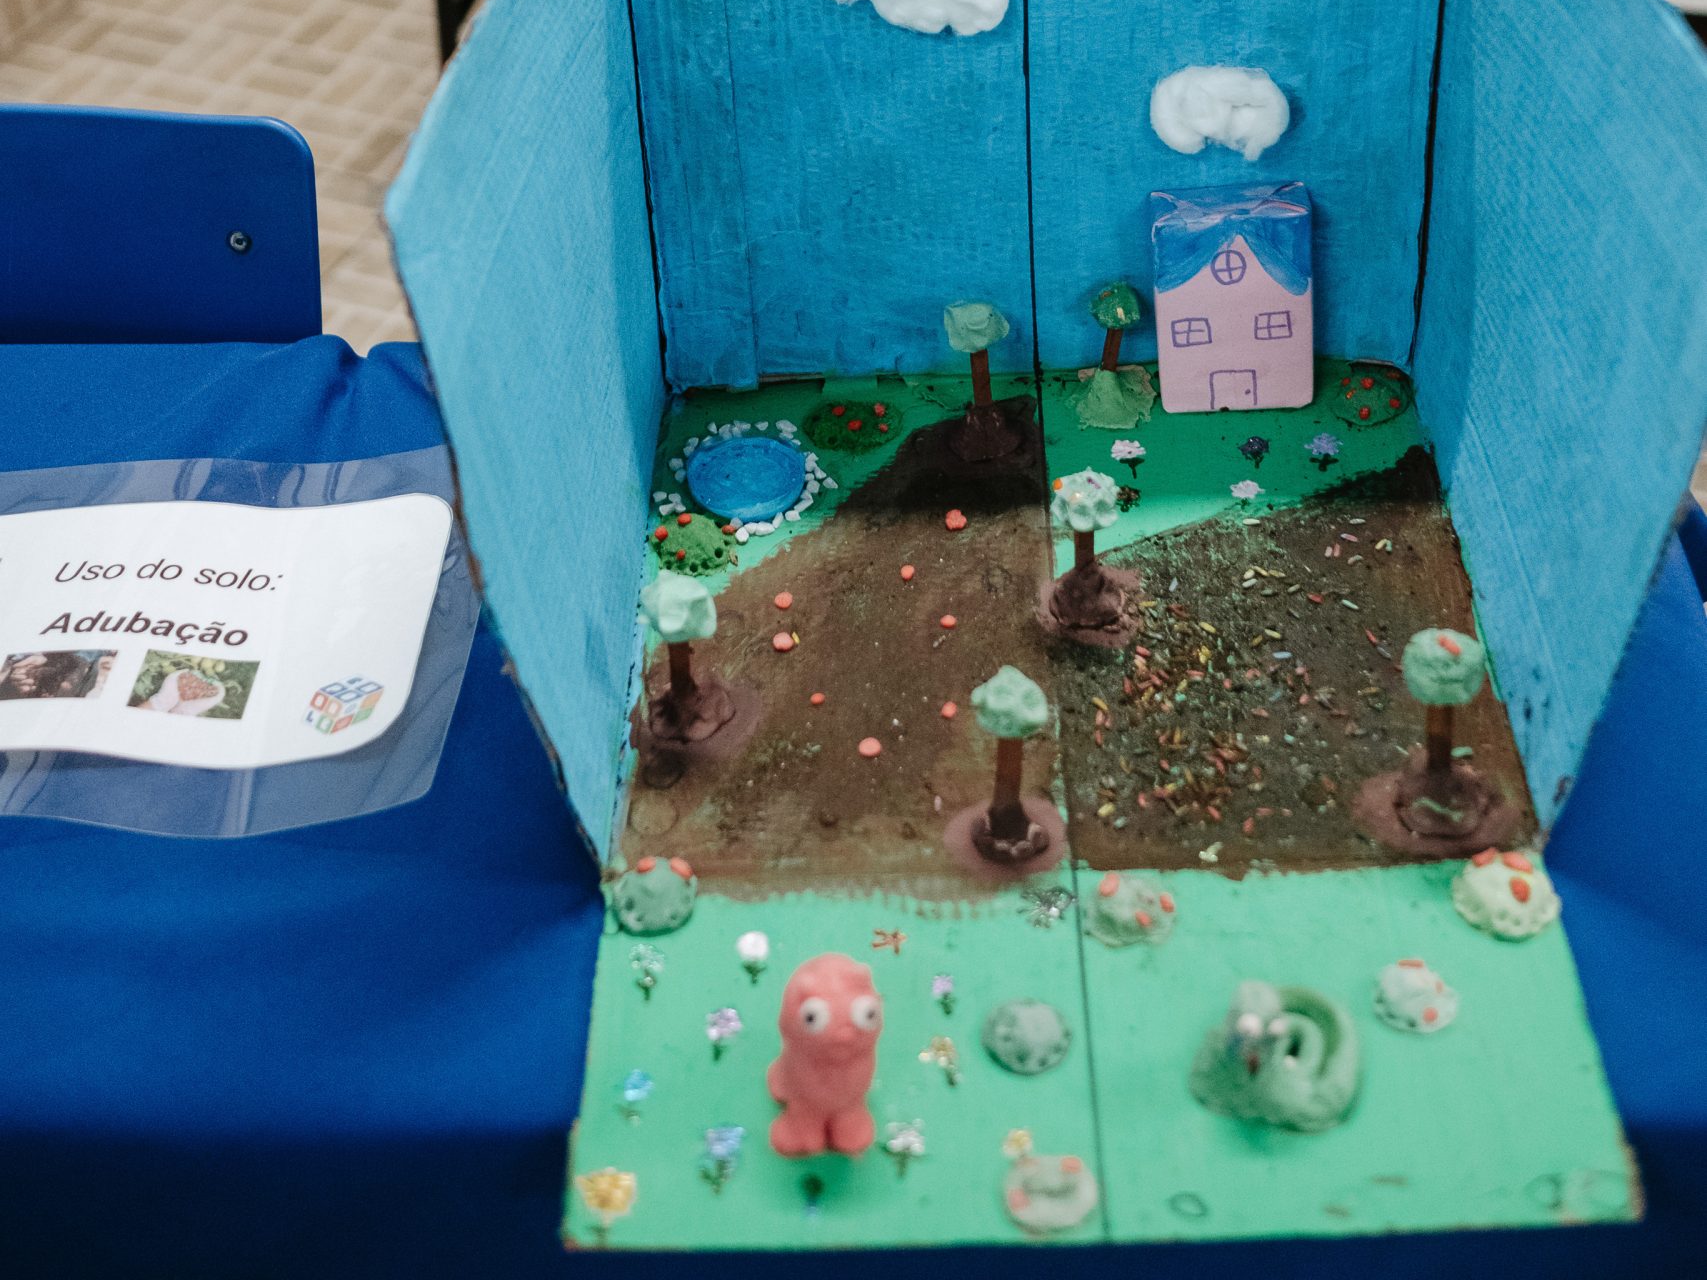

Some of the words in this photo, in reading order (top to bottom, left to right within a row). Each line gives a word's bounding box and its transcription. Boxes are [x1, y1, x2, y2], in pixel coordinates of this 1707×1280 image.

[54, 560, 125, 584] Uso
[136, 558, 183, 582] do
[193, 567, 284, 592] solo:
[40, 610, 250, 647] Adubação
